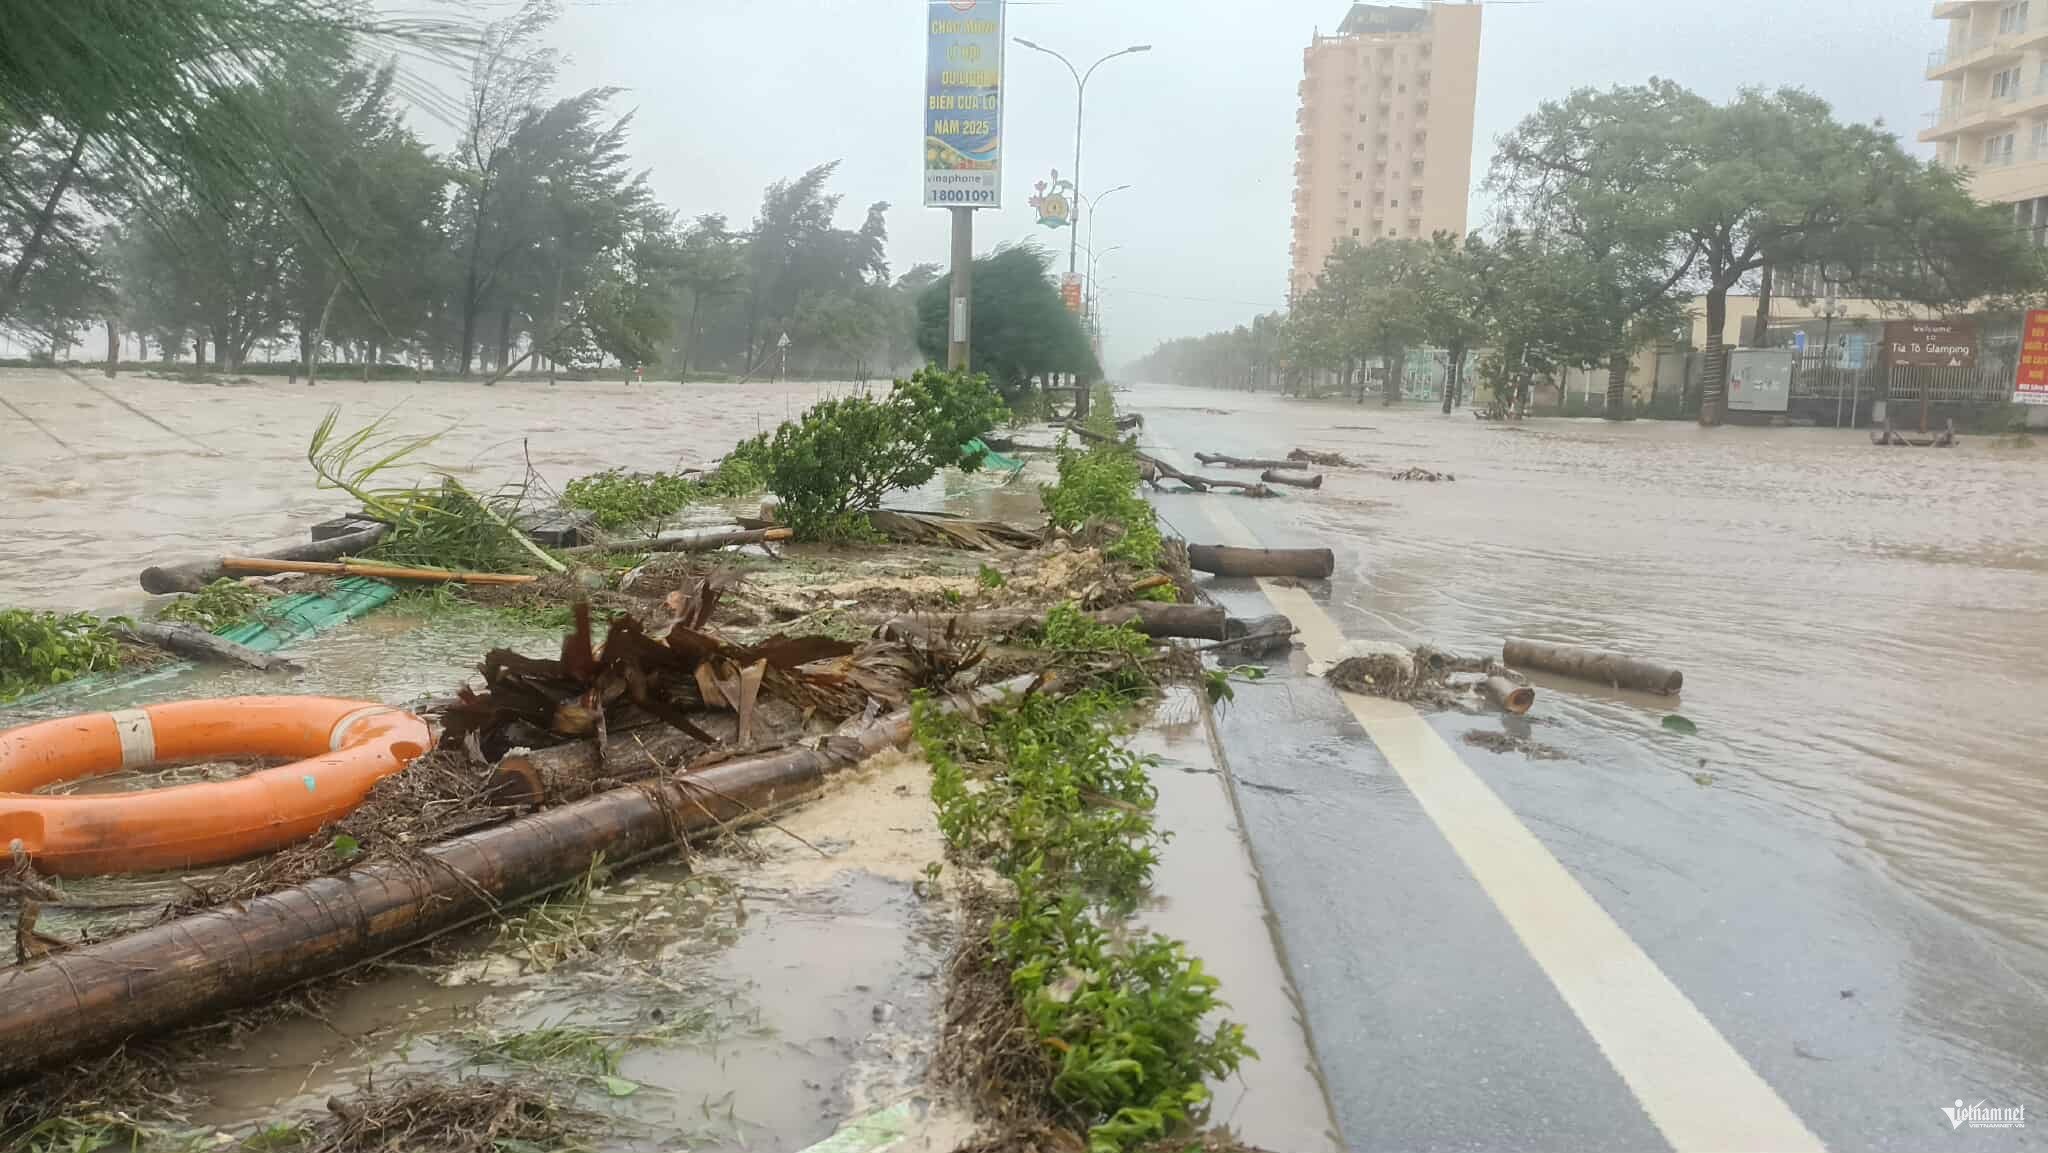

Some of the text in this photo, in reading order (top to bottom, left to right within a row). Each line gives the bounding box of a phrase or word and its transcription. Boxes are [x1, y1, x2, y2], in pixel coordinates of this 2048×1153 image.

[962, 121, 990, 135] 2025
[928, 174, 981, 184] vinaphone
[932, 190, 994, 201] 18001091
[1926, 343, 1969, 356] Glamping
